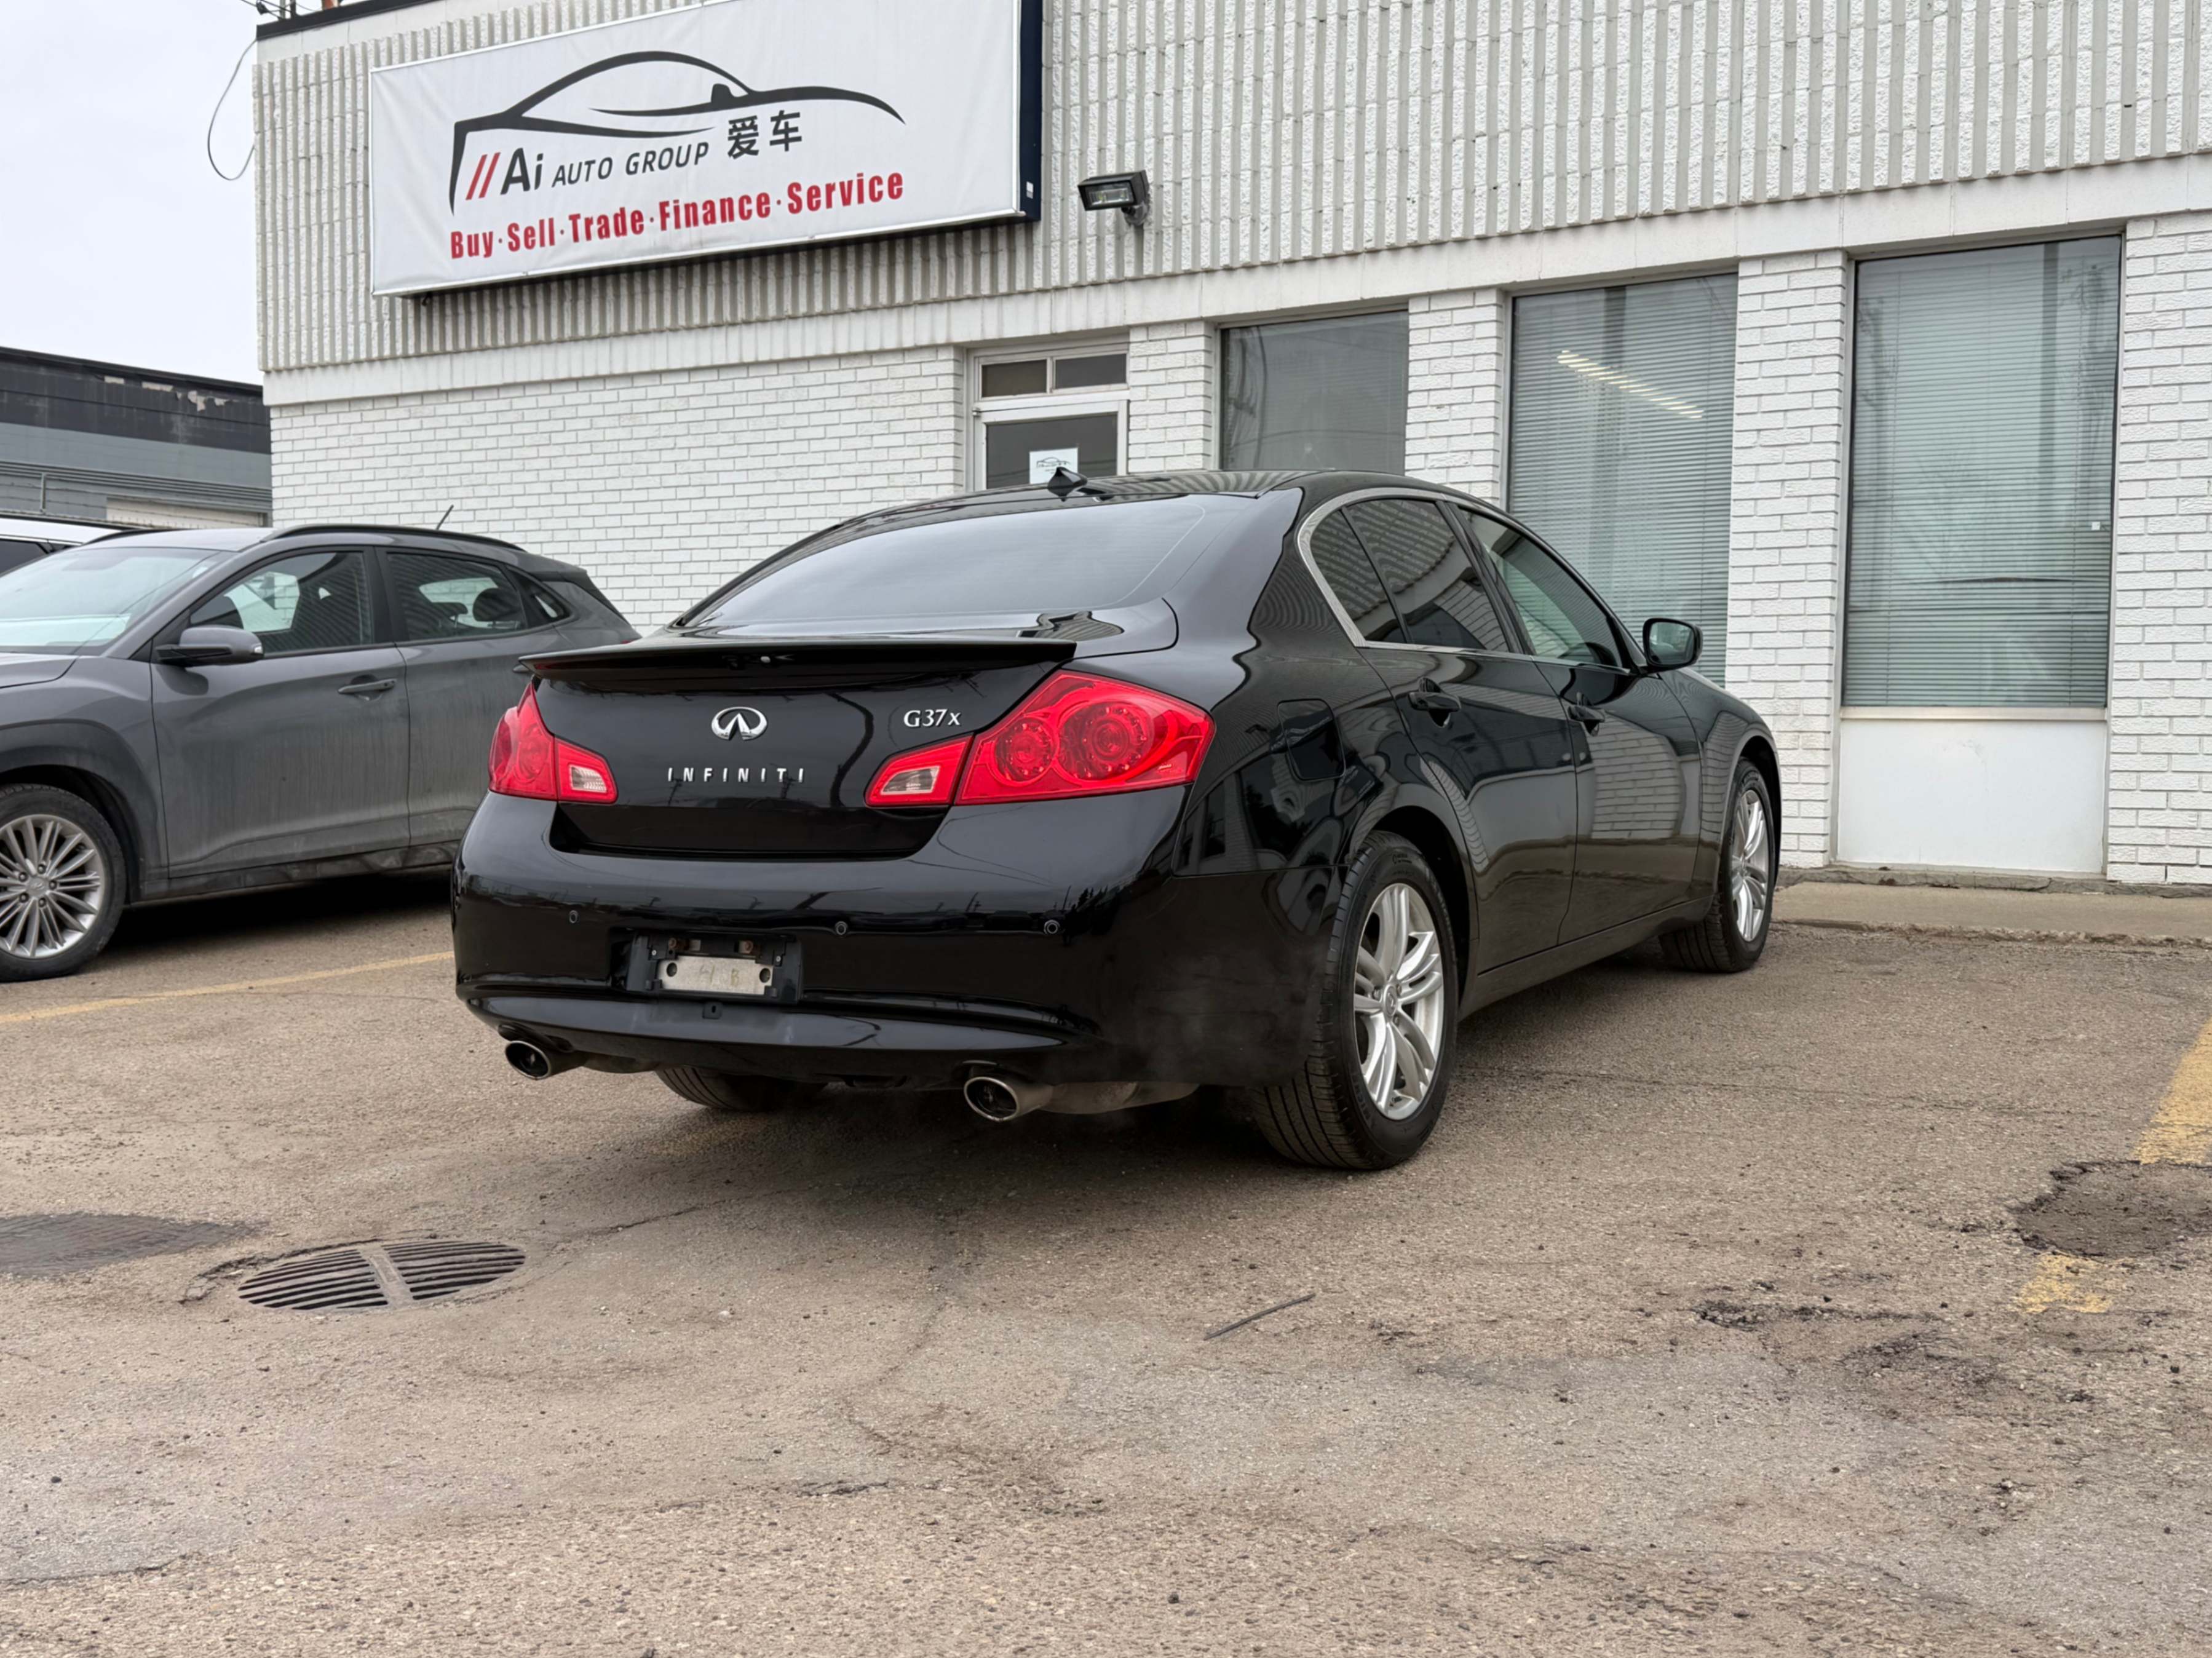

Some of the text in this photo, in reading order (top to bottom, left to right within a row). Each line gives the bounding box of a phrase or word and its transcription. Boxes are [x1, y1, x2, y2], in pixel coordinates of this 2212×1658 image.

[727, 110, 802, 159] 爱车
[552, 157, 613, 188] AUTO
[625, 141, 709, 176] GROUP
[667, 768, 804, 783] INFINITI
